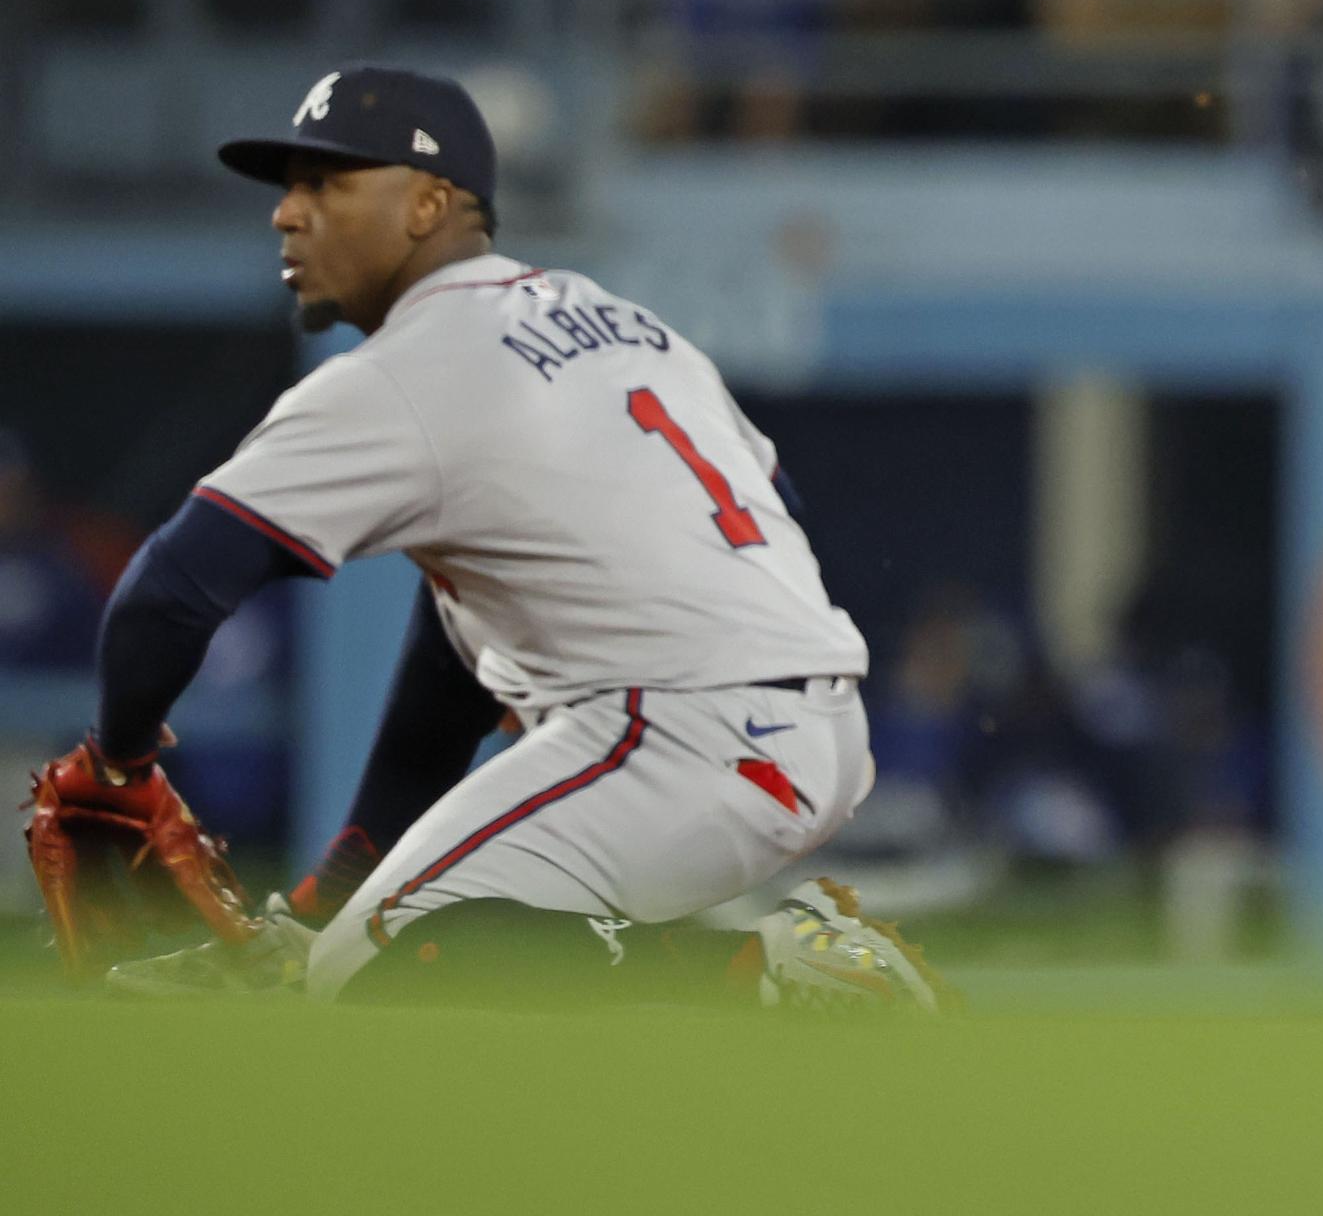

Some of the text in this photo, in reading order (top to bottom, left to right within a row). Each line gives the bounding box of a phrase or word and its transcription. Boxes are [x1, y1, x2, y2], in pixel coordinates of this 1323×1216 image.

[292, 71, 342, 127] A
[501, 305, 670, 383] ALBIES
[626, 386, 769, 550] 1
